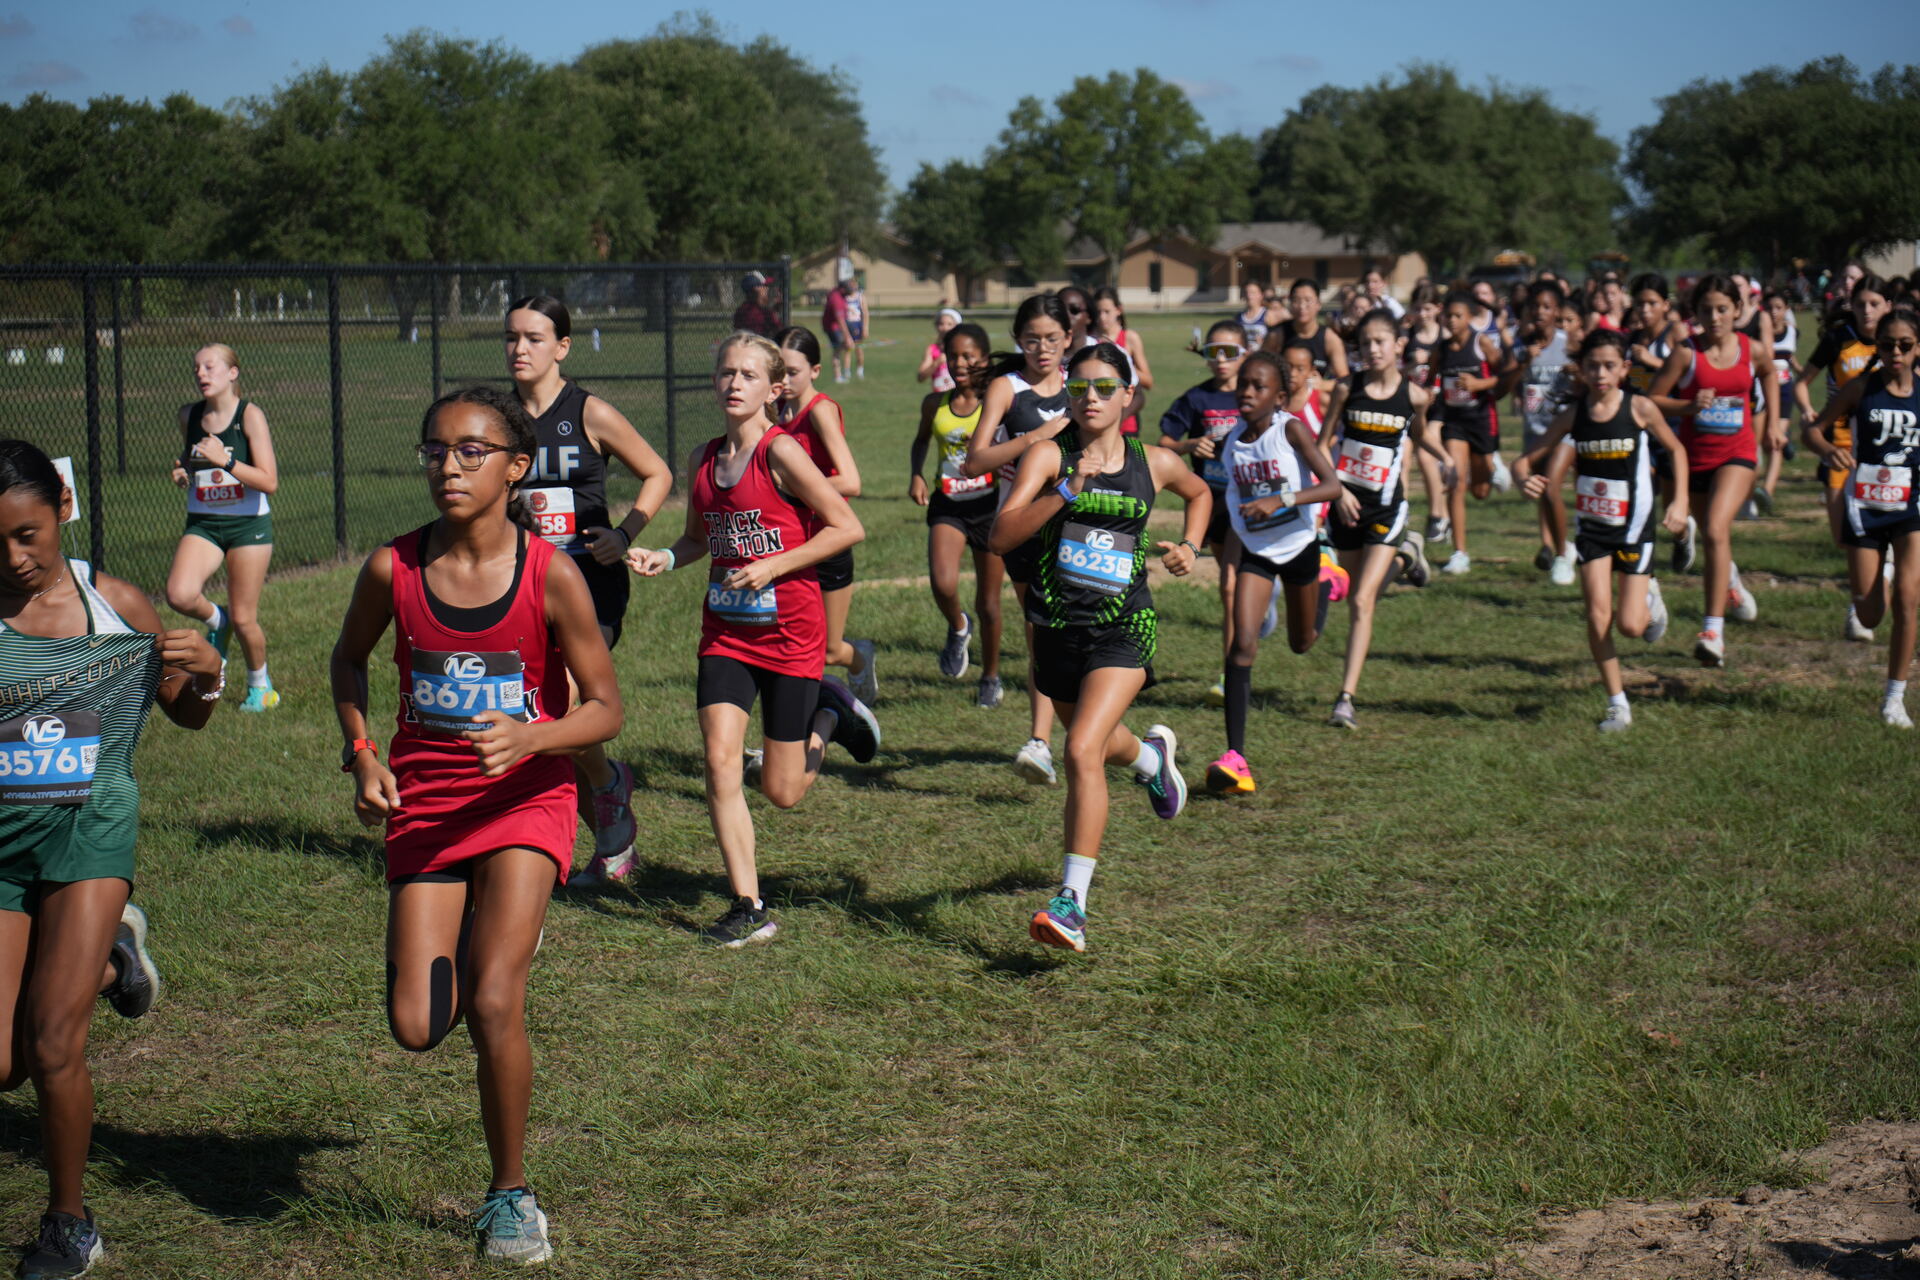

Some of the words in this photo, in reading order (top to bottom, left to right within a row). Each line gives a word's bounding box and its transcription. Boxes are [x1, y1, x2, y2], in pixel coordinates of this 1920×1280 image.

[1346, 410, 1406, 430] TIGERS
[1577, 438, 1635, 454] TIGERS
[528, 446, 580, 481] LF
[1344, 459, 1383, 481] 1454
[203, 486, 237, 500] 1061
[1071, 491, 1137, 518] SWIFT
[1861, 485, 1904, 500] 1489
[1582, 498, 1620, 515] 1455
[534, 515, 567, 534] 58
[703, 509, 765, 535] TRACK
[708, 528, 785, 558] OUSTON
[1059, 545, 1117, 574] 8623
[709, 588, 758, 608] 8674
[444, 653, 486, 682] NS
[414, 679, 497, 710] 8671
[22, 715, 66, 747] NS
[0, 748, 78, 777] 8576
[3, 788, 91, 799] MYNEGATIVESPLIT.CO
